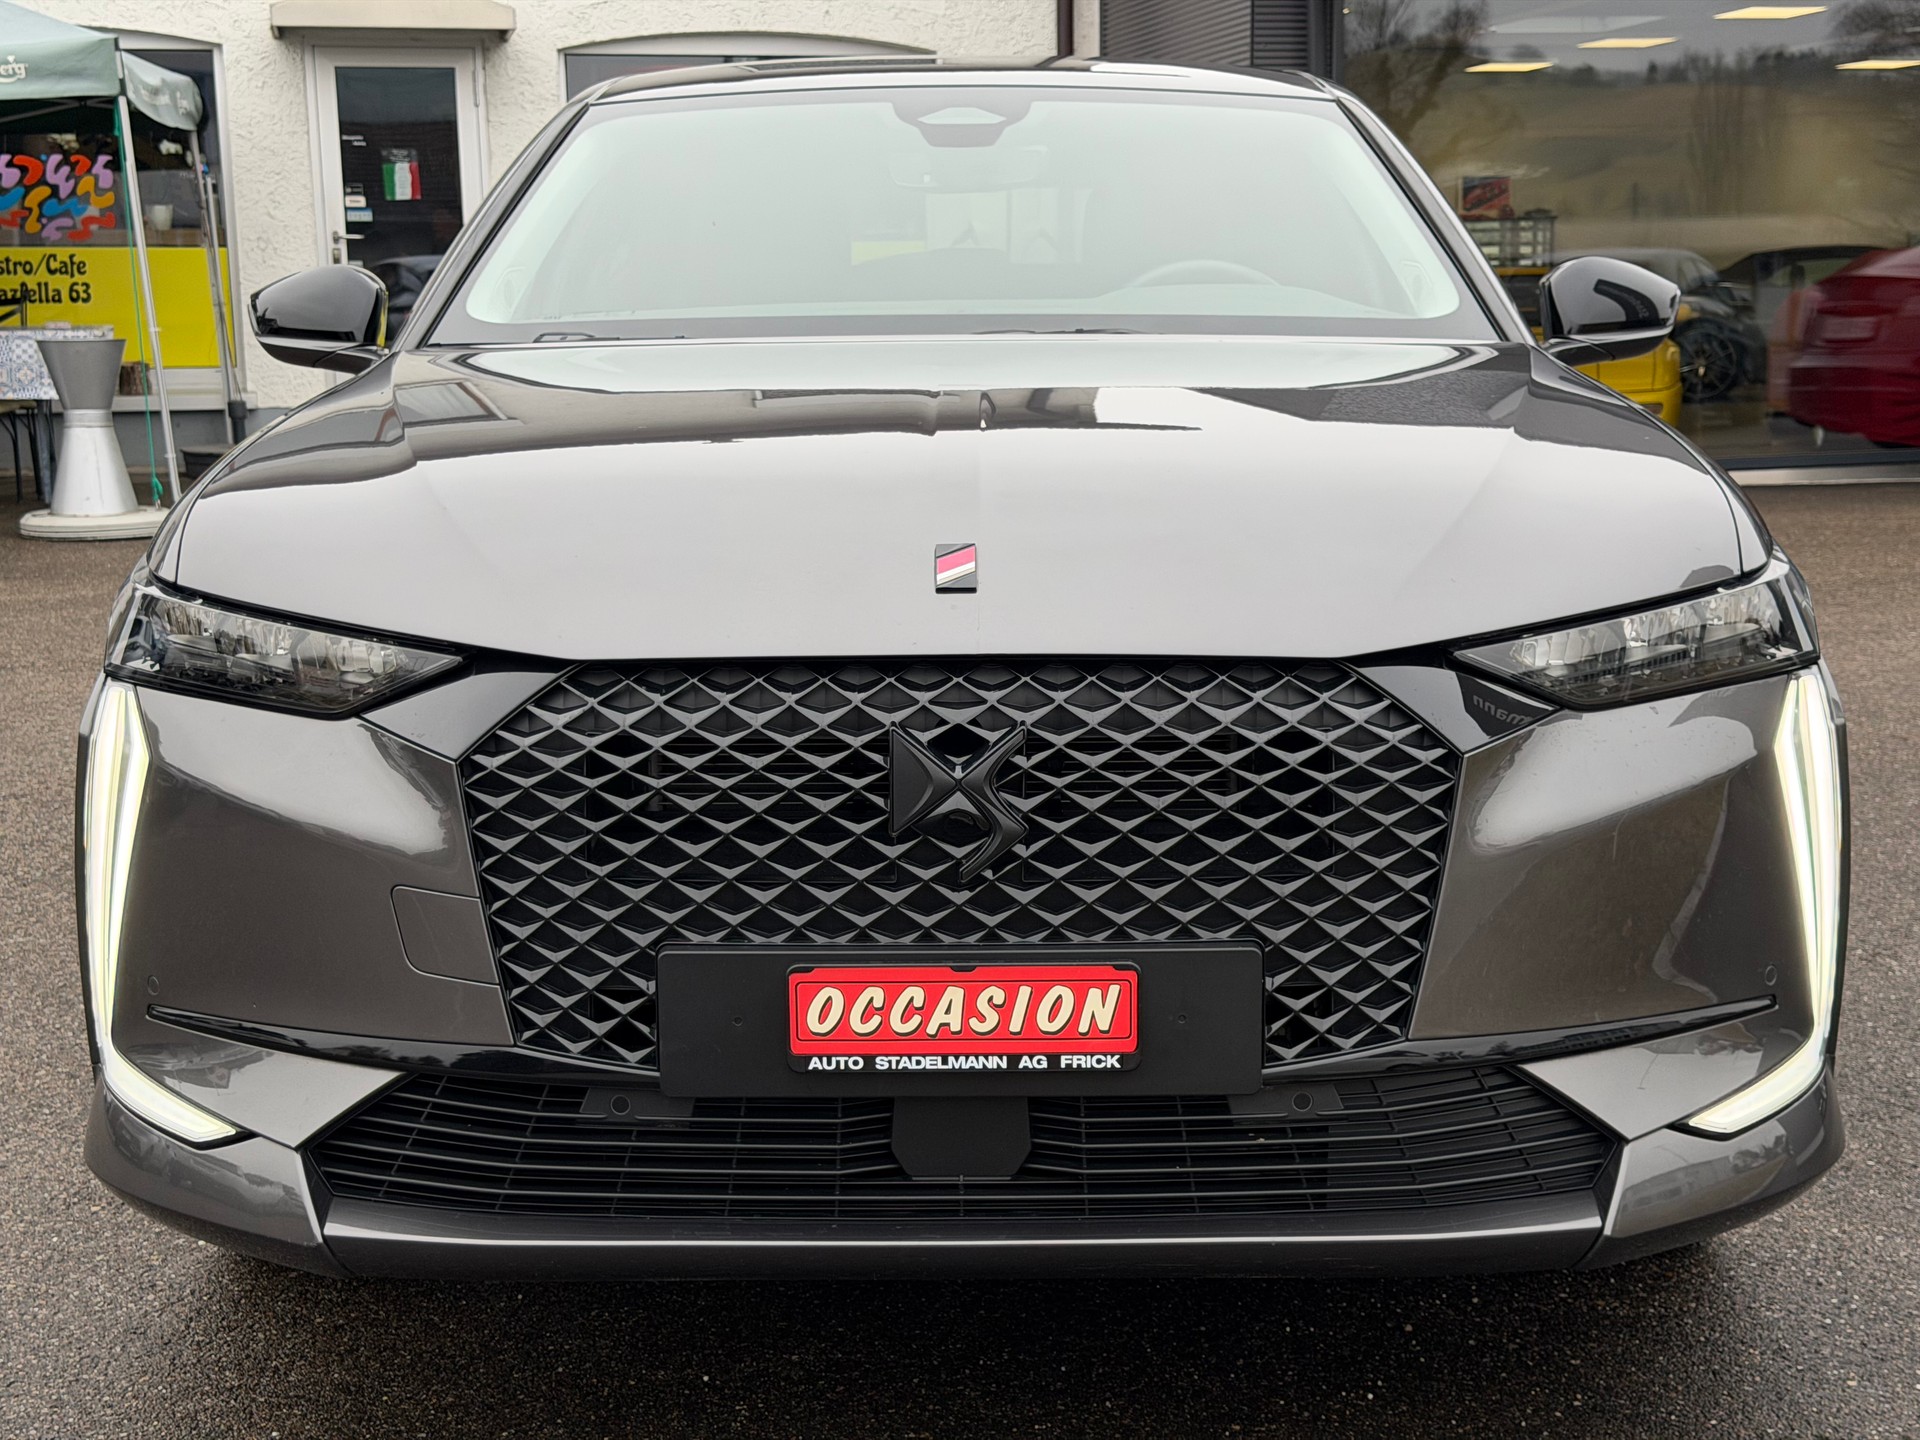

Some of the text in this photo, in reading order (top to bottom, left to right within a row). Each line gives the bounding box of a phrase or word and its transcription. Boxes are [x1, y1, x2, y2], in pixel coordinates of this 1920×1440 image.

[69, 282, 92, 304] 63
[806, 984, 1121, 1039] OCCASION
[808, 1054, 1121, 1070] AUTO STADELMANN AG FRICK
